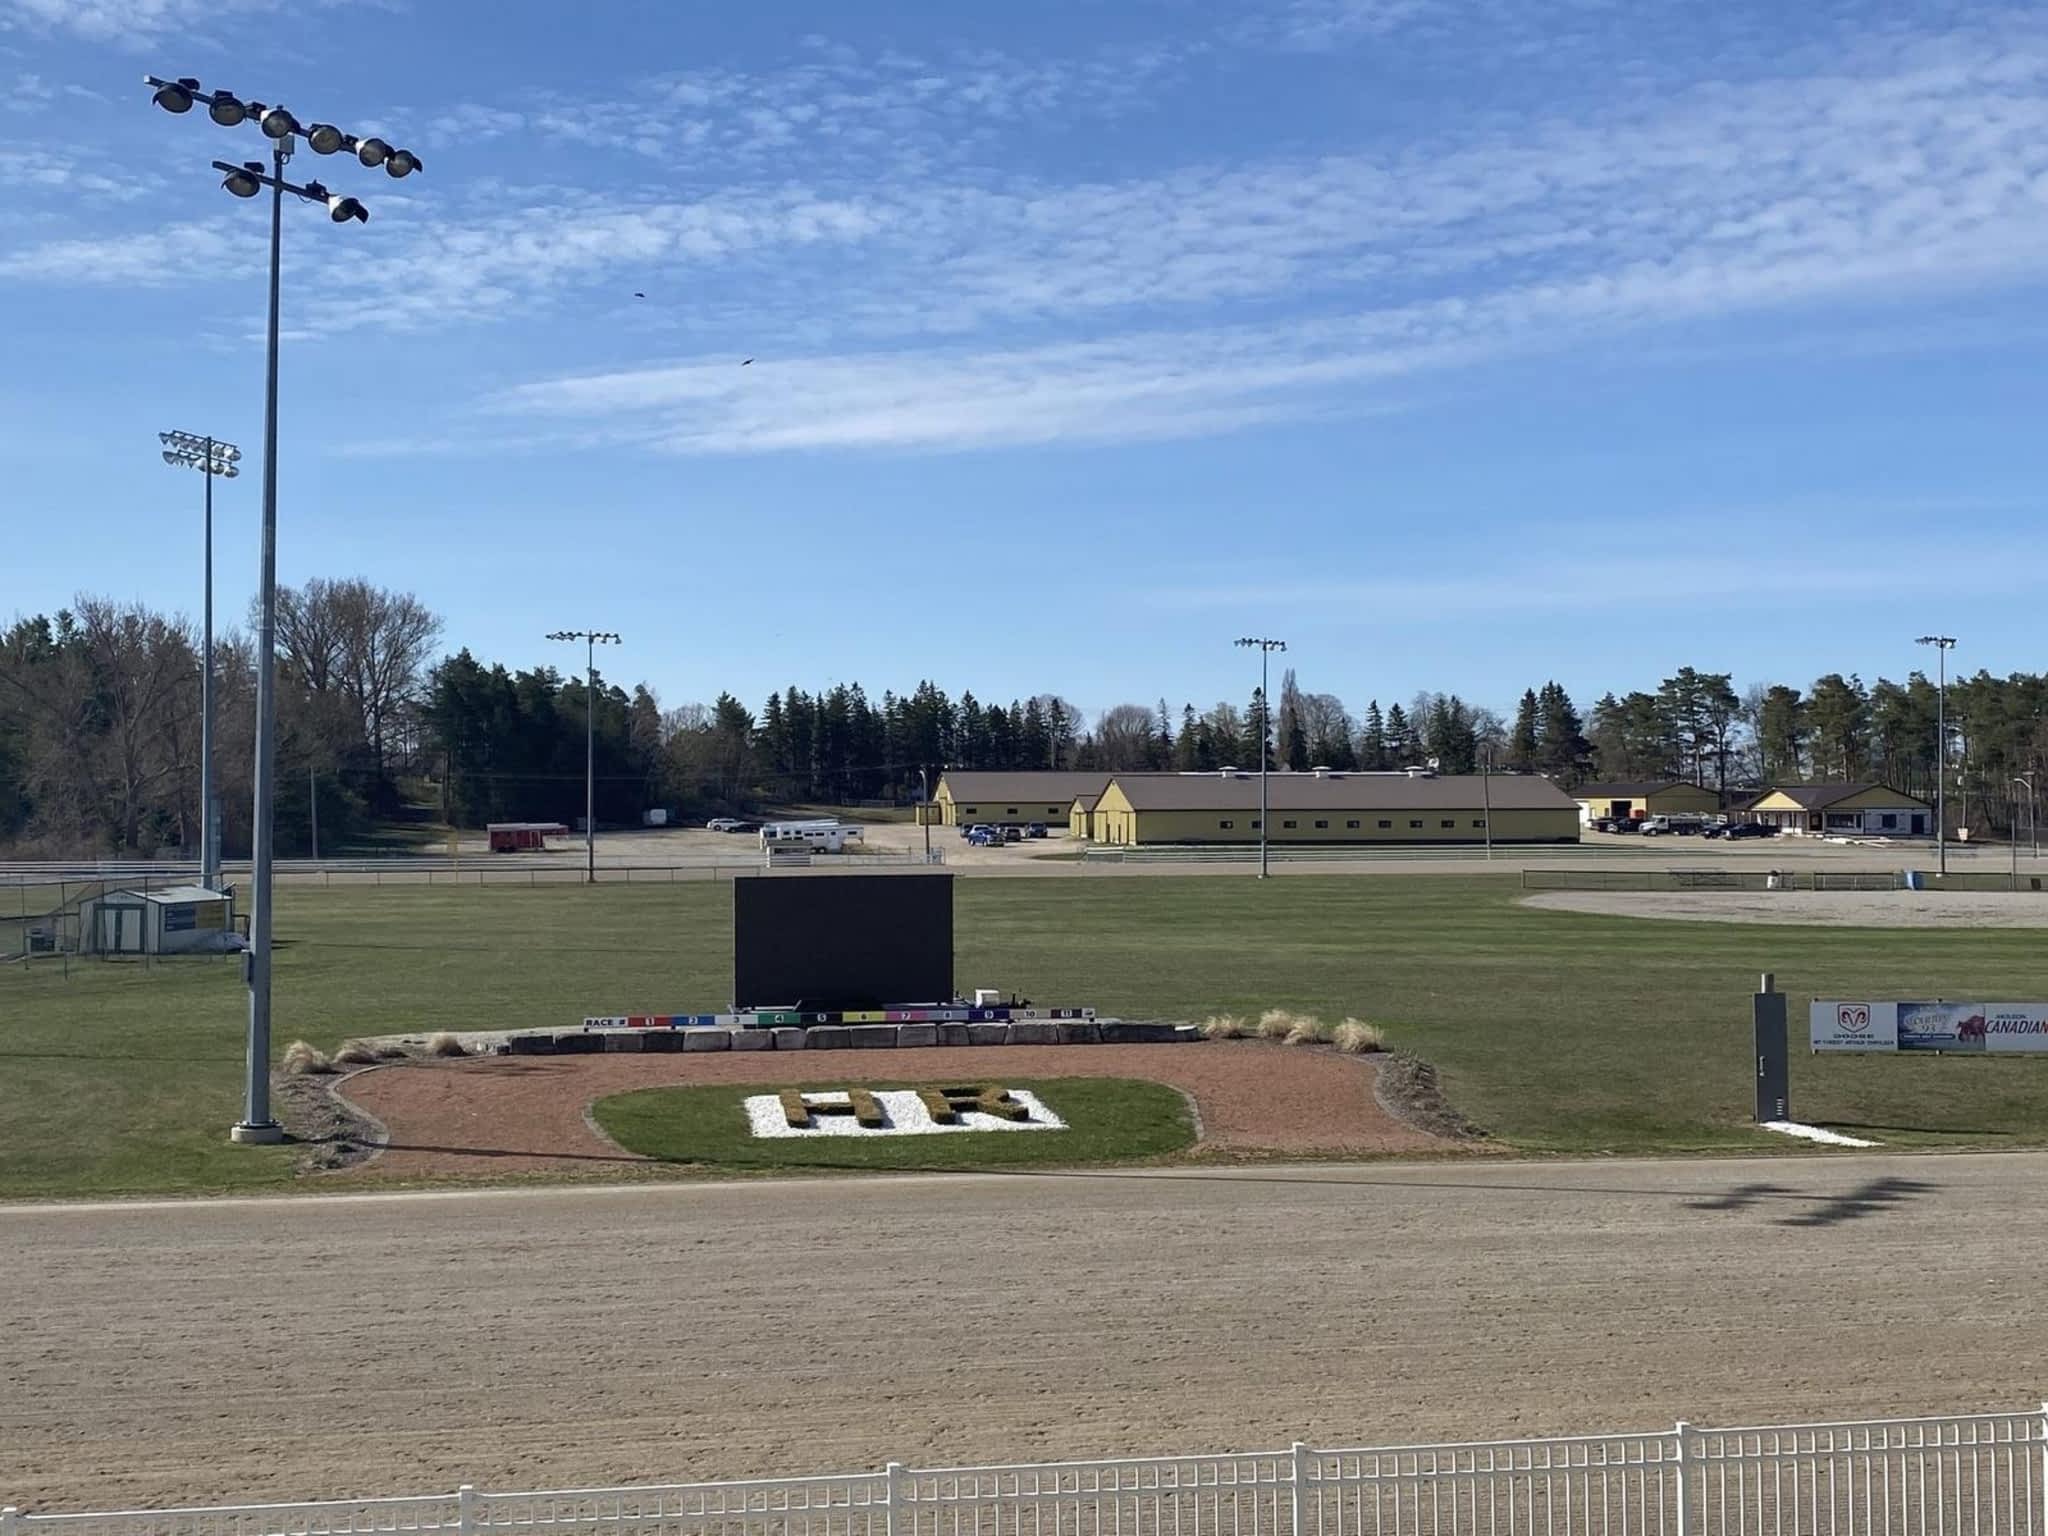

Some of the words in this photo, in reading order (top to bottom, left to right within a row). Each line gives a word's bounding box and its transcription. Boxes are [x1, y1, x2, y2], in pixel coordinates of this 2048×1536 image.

[586, 1018, 614, 1027] RACE
[689, 1015, 698, 1025] 2
[733, 1015, 740, 1024] 3
[774, 1014, 784, 1023] 4
[817, 1013, 827, 1022] 5
[860, 1012, 868, 1020] 6
[902, 1011, 911, 1020] 7
[943, 1010, 952, 1020] 8
[984, 1009, 994, 1019] 9
[1024, 1009, 1036, 1018] 10
[1061, 1009, 1073, 1018] 11
[1984, 1019, 2047, 1034] CANADIAN
[779, 1087, 1030, 1129] HR
